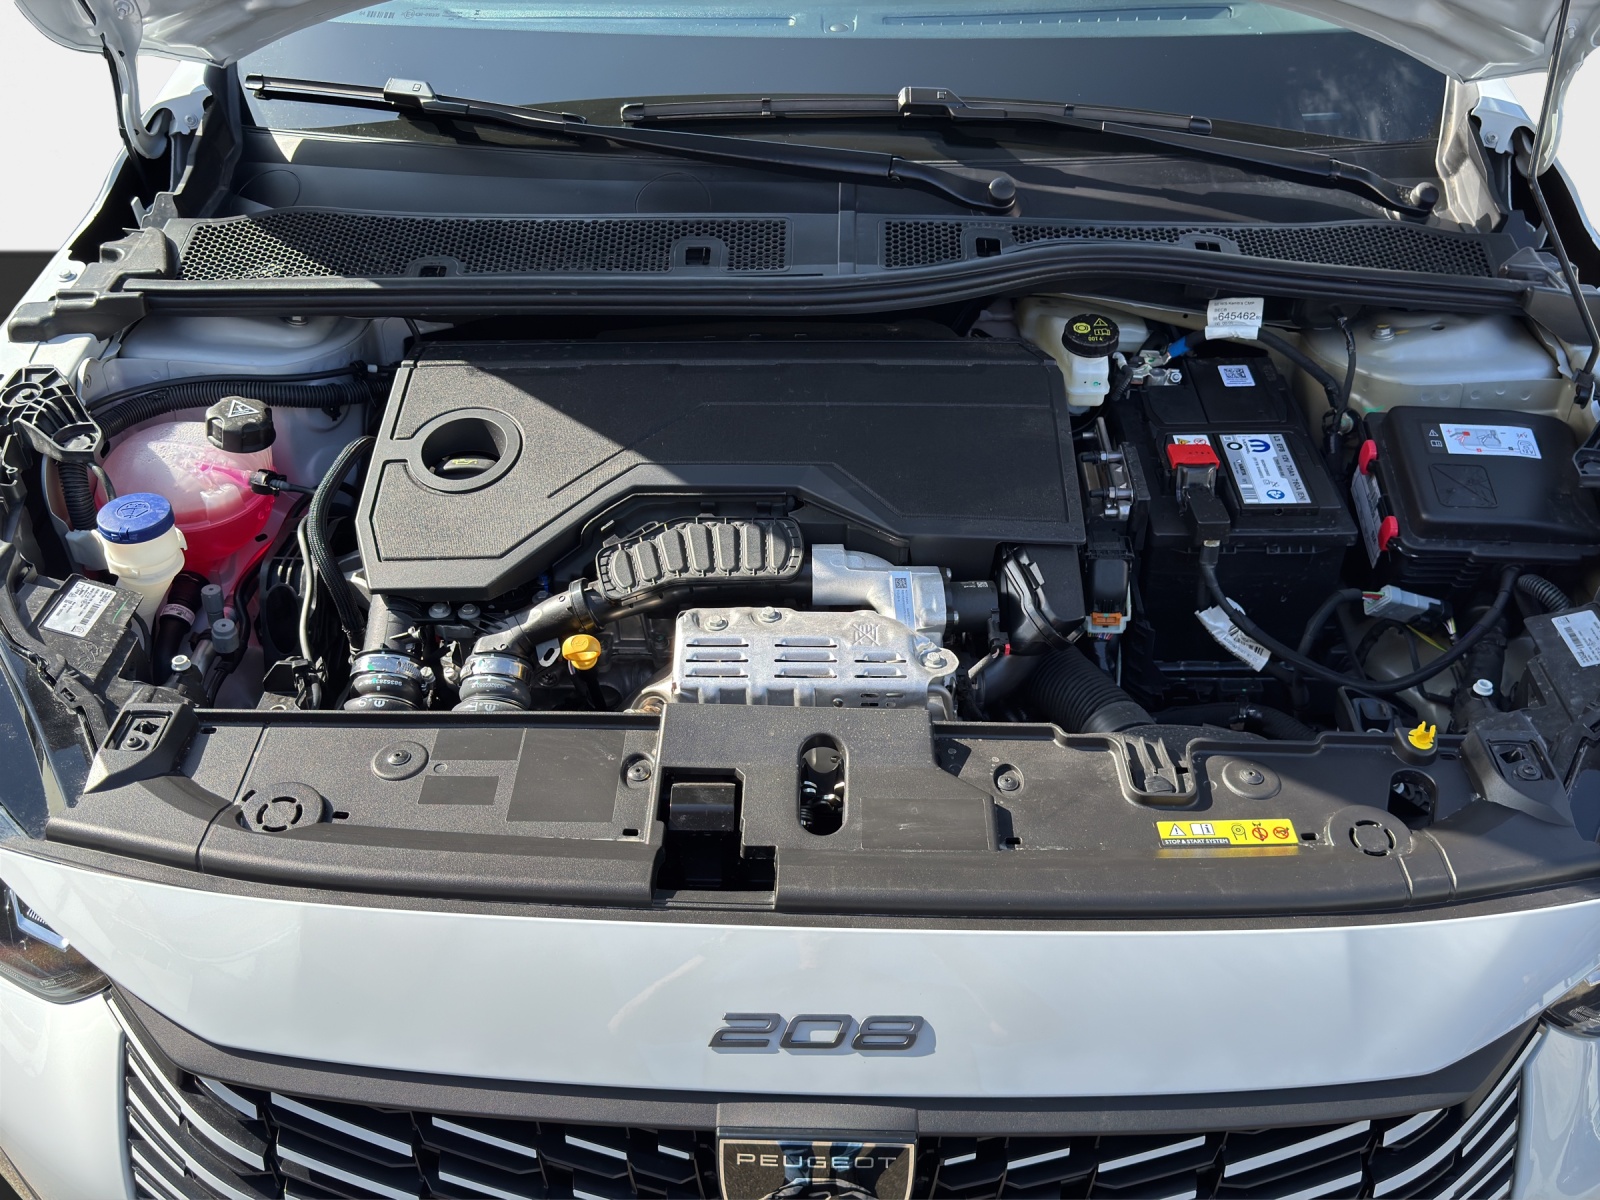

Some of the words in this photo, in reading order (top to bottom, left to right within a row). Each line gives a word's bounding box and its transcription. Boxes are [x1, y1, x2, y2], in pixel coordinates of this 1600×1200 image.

[1218, 311, 1256, 321] 645462
[708, 1012, 925, 1051] 208
[736, 1153, 897, 1169] PEUGEOT
